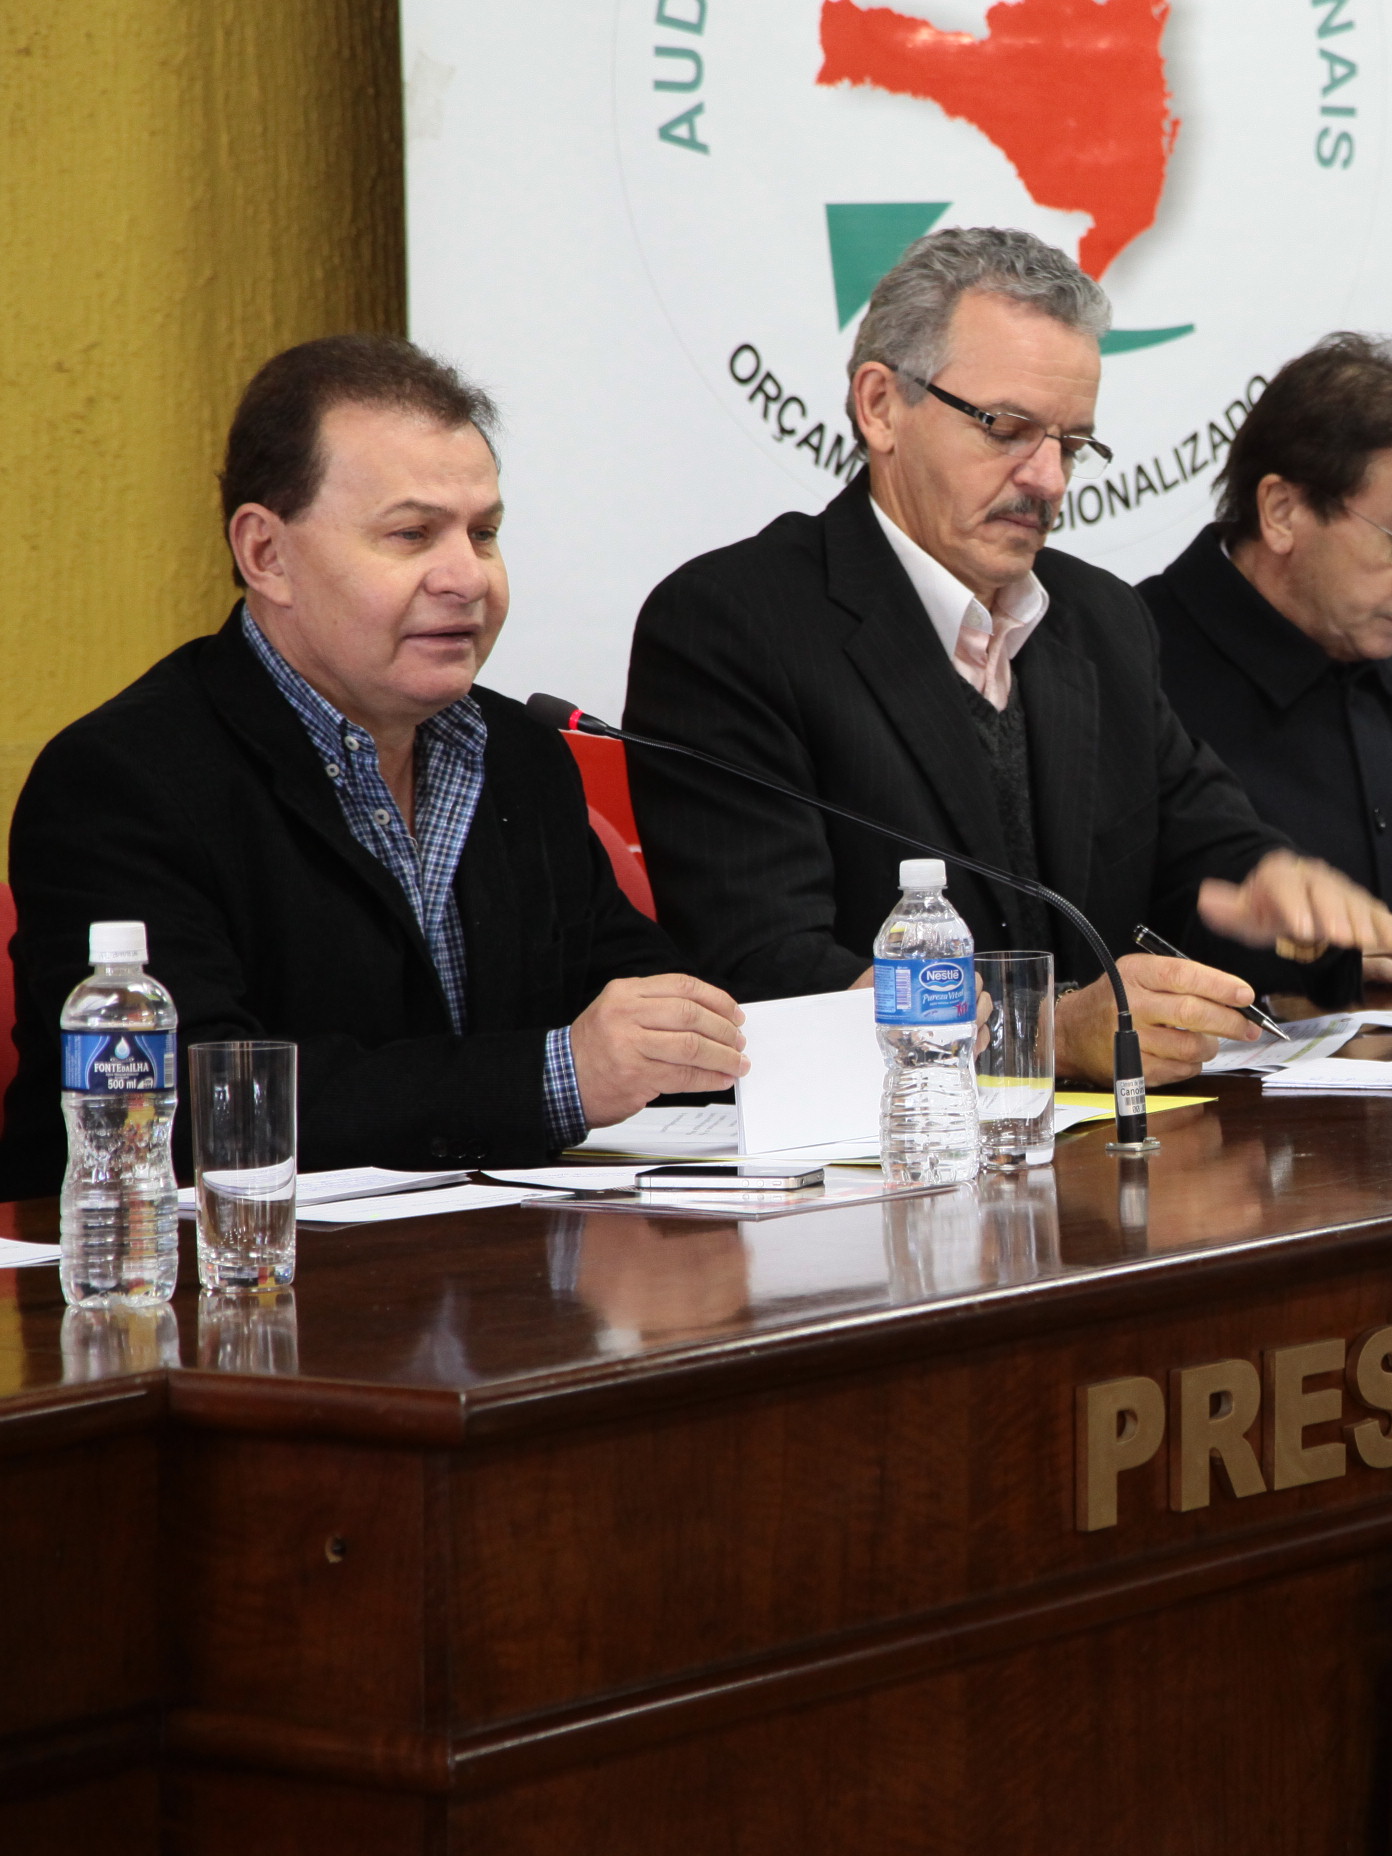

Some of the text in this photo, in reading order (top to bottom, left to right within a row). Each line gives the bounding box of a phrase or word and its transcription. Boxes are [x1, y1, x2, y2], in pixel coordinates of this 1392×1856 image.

[926, 969, 960, 981] Nestlé
[107, 1079, 138, 1090] 500 ml
